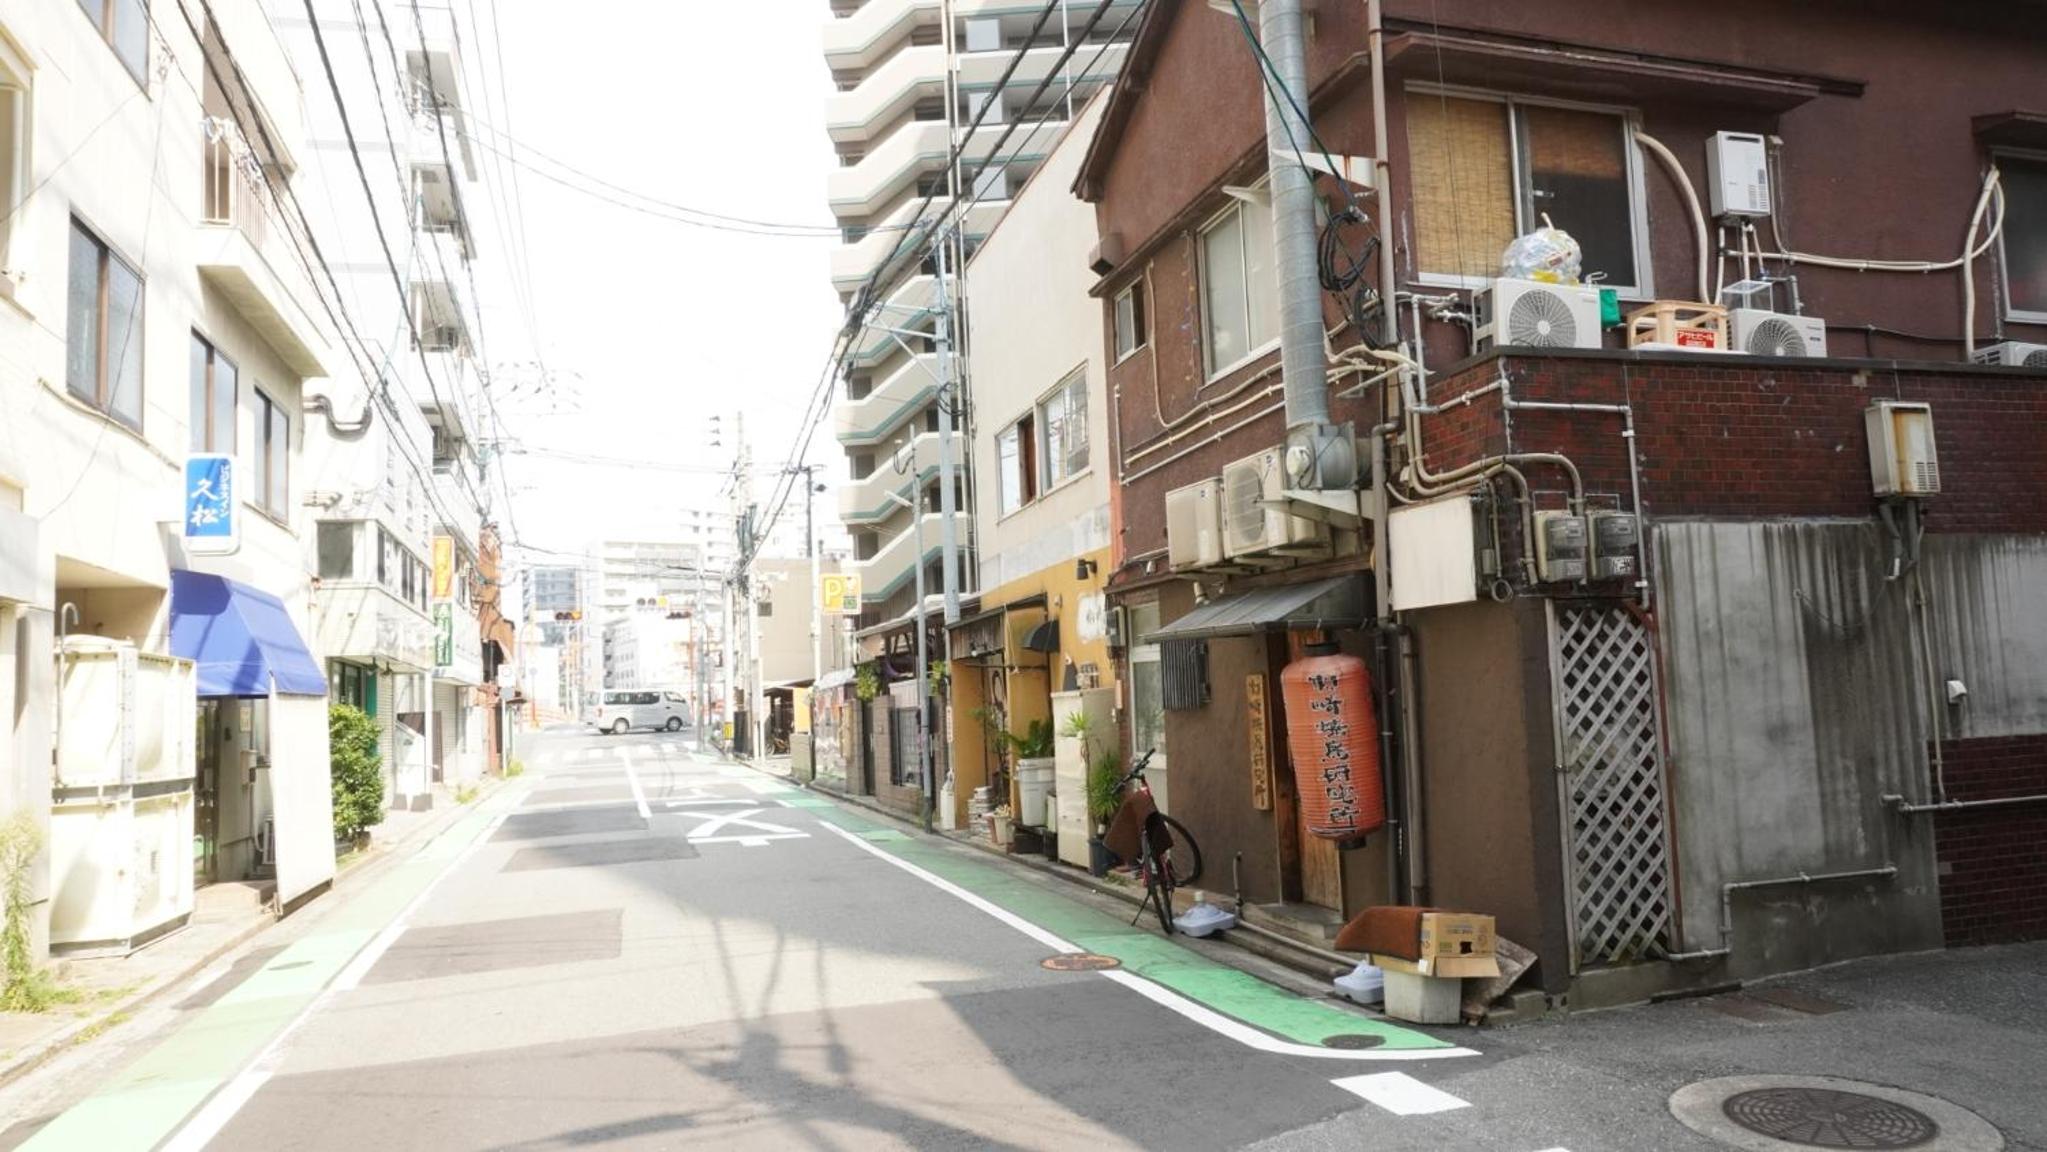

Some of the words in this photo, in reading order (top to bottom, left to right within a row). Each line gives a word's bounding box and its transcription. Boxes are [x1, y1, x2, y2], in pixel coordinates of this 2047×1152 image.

[1679, 331, 1714, 341] アサヒビール
[191, 478, 218, 526] 久松
[825, 578, 842, 605] P
